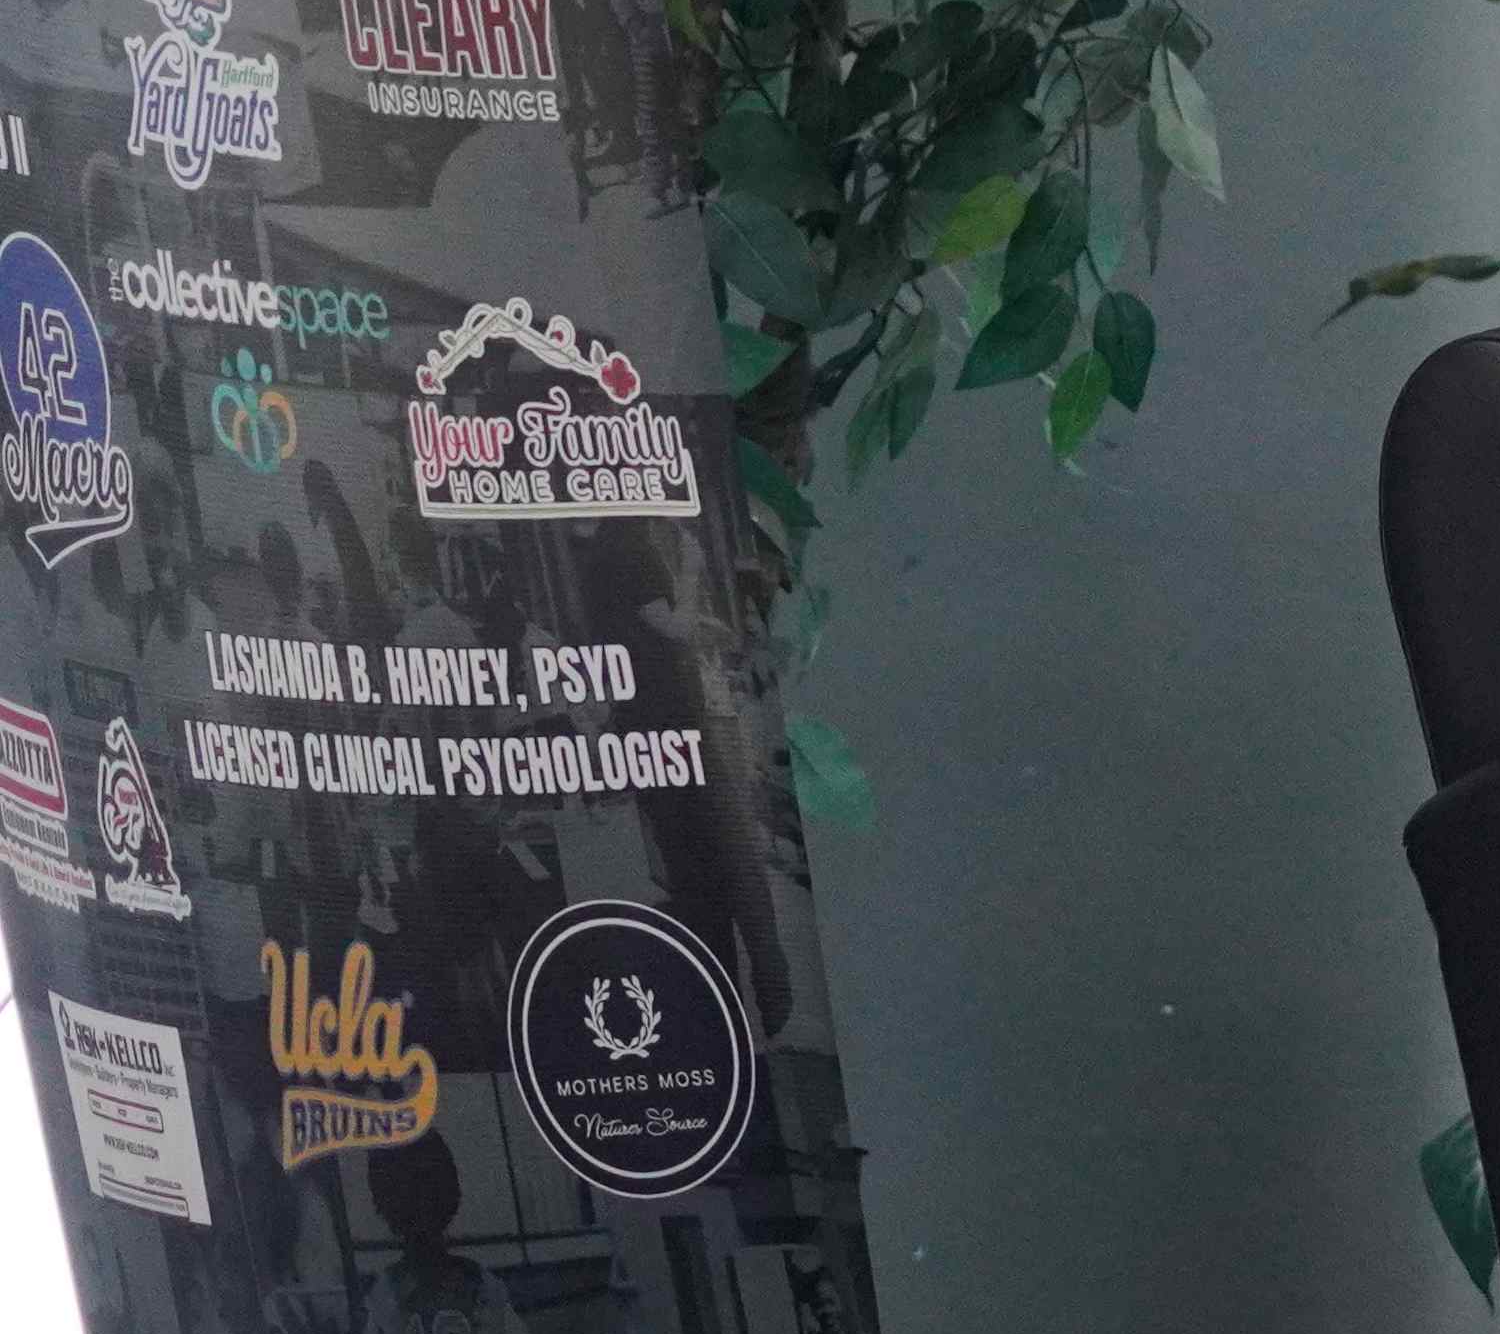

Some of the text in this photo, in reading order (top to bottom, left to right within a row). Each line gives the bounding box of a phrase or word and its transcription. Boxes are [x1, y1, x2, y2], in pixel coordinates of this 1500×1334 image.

[367, 81, 561, 122] INSURANCE
[18, 302, 88, 425] 42
[4, 411, 134, 525] Macro
[408, 385, 687, 489] Your Family
[448, 467, 666, 505] HOME CARE
[205, 631, 637, 713] LASHANDA B. HARVEY, PSYD
[184, 720, 706, 796] LICENSED CLINICAL PSYCHOLOGIST
[556, 1069, 716, 1097] MOTHERS MOSS
[289, 1098, 418, 1157] BRUINS
[645, 1107, 709, 1137] Source
